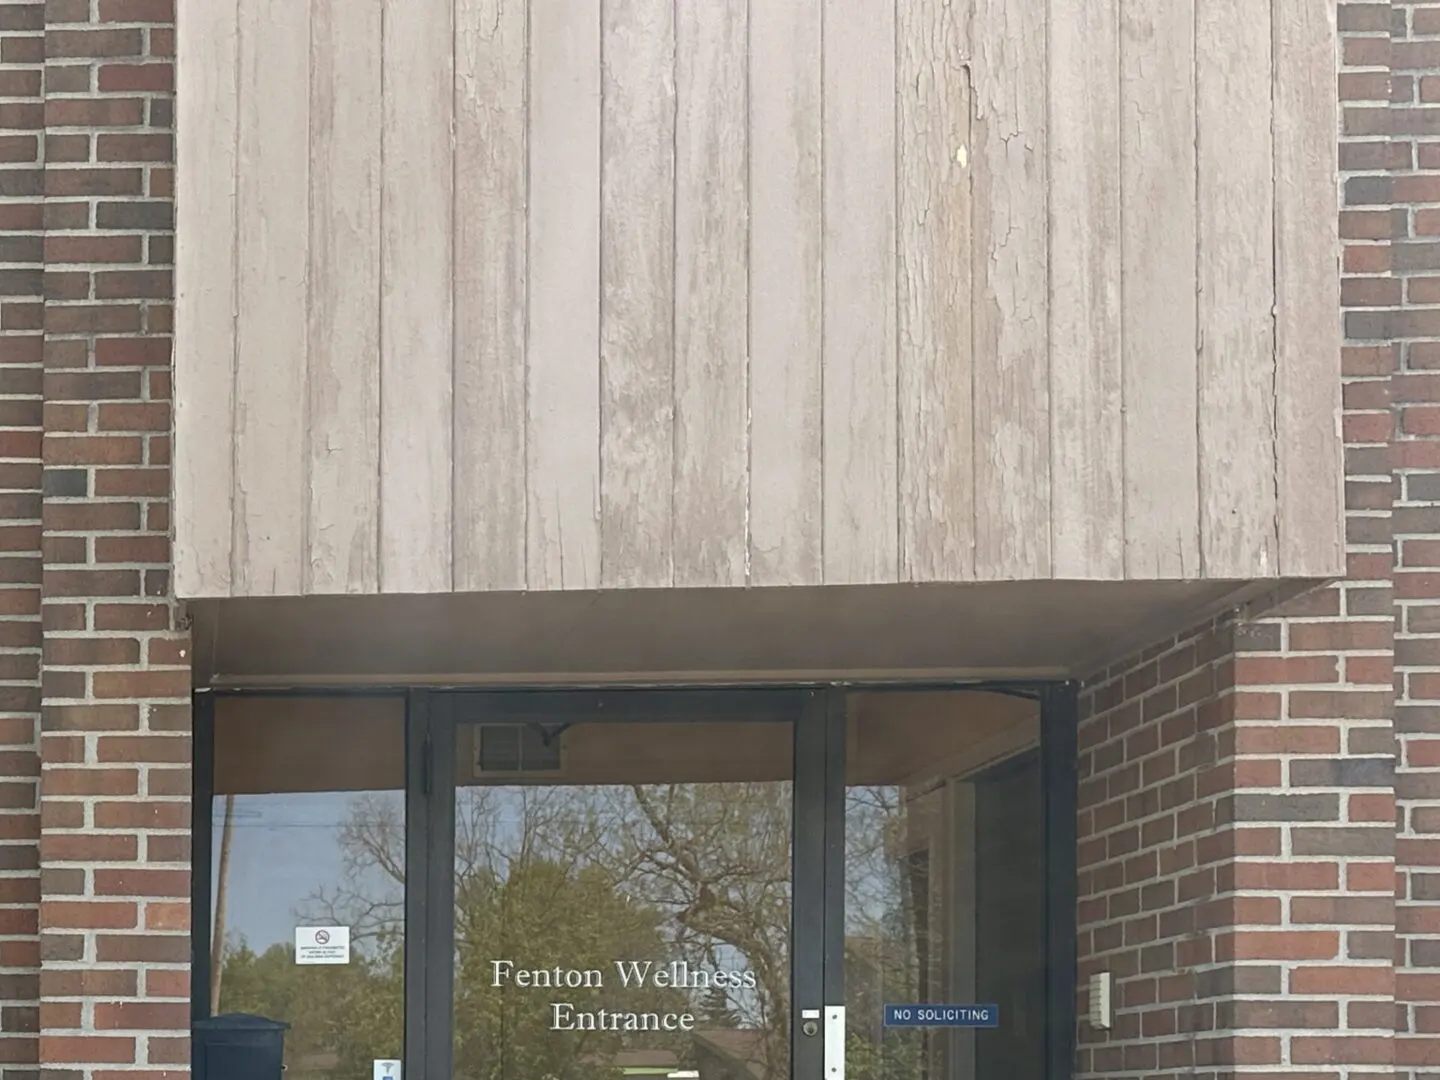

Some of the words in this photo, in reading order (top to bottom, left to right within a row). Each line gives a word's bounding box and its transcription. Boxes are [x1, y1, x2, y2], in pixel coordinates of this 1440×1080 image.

[490, 960, 603, 988] Fenton
[616, 960, 757, 989] Wellness
[550, 1003, 695, 1031] Entrance
[894, 1009, 911, 1020] NO
[917, 1009, 989, 1021] SOLICITING
